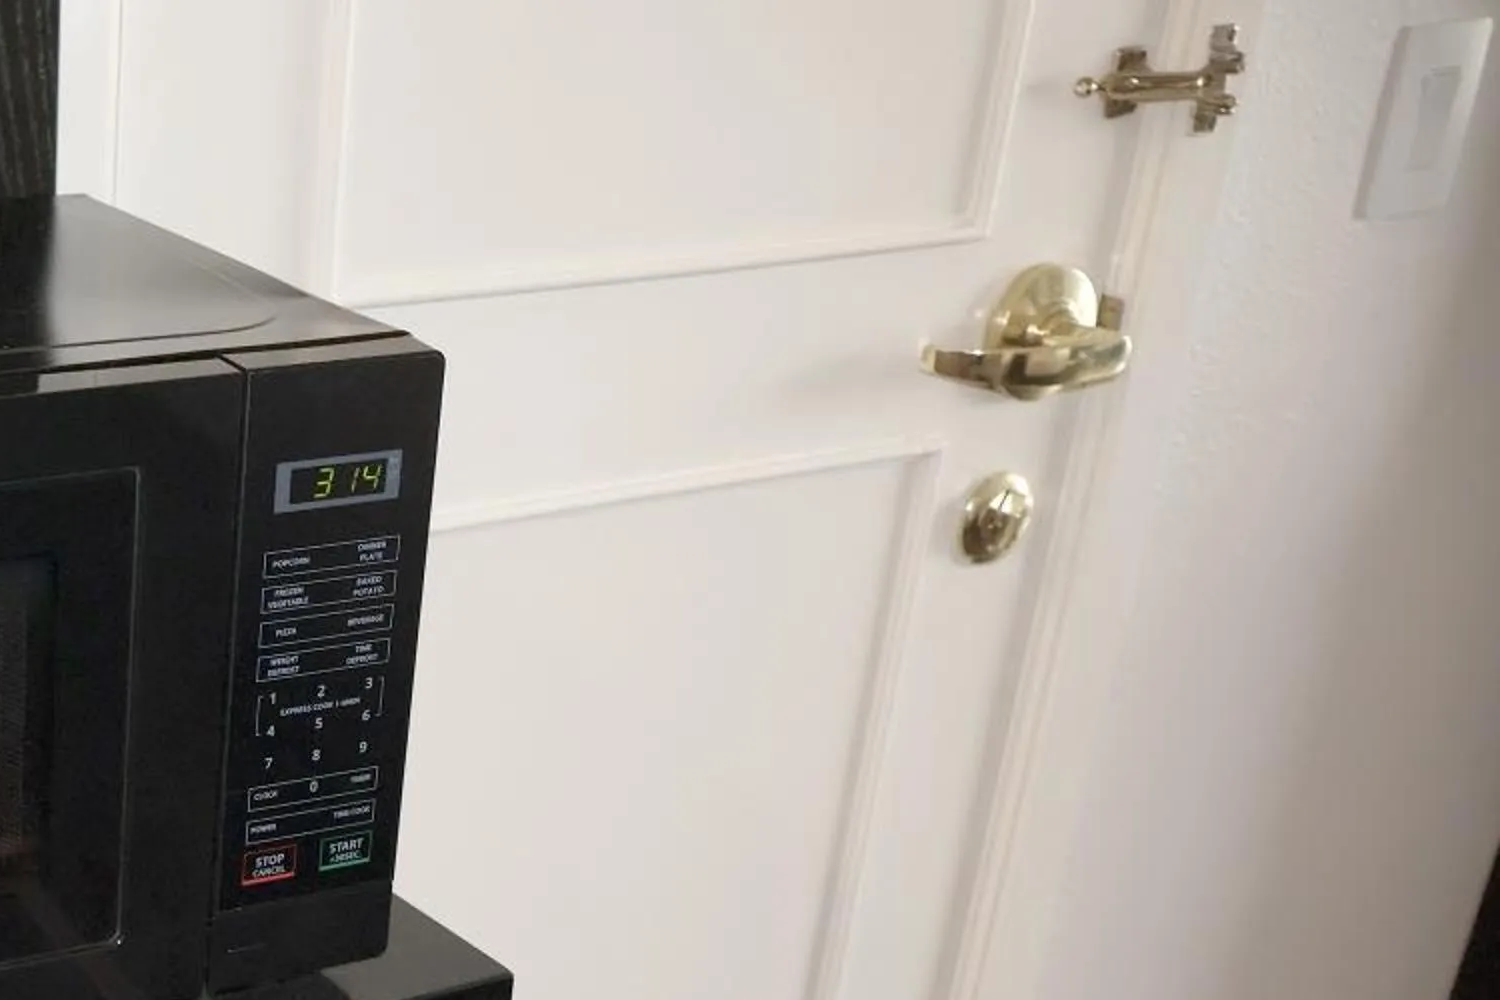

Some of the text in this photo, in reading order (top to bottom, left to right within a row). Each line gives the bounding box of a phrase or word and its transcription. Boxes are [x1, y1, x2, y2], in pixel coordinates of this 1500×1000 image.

[359, 551, 383, 561] PLATE
[272, 556, 311, 570] POPCORN
[274, 586, 305, 597] FROZEN
[352, 585, 385, 597] POTATO
[267, 596, 309, 609] VEGETABLE
[347, 613, 385, 627] BEVERAGE
[275, 627, 297, 638] PIZZA
[355, 643, 373, 653] TIME
[364, 676, 373, 689] 3
[317, 684, 326, 698] 2
[269, 692, 277, 705] 1
[280, 703, 312, 717] EXPRESS
[361, 708, 371, 721] 6
[314, 717, 323, 729] 5
[266, 724, 276, 737] 4
[359, 740, 368, 753] 9
[311, 748, 321, 761] 8
[264, 757, 273, 769] 7
[309, 780, 319, 793] 0
[253, 789, 279, 801] CLOCK
[250, 823, 277, 835] POWER
[328, 837, 365, 854] START
[254, 852, 285, 869] STOP
[251, 864, 286, 877] CANCEL
